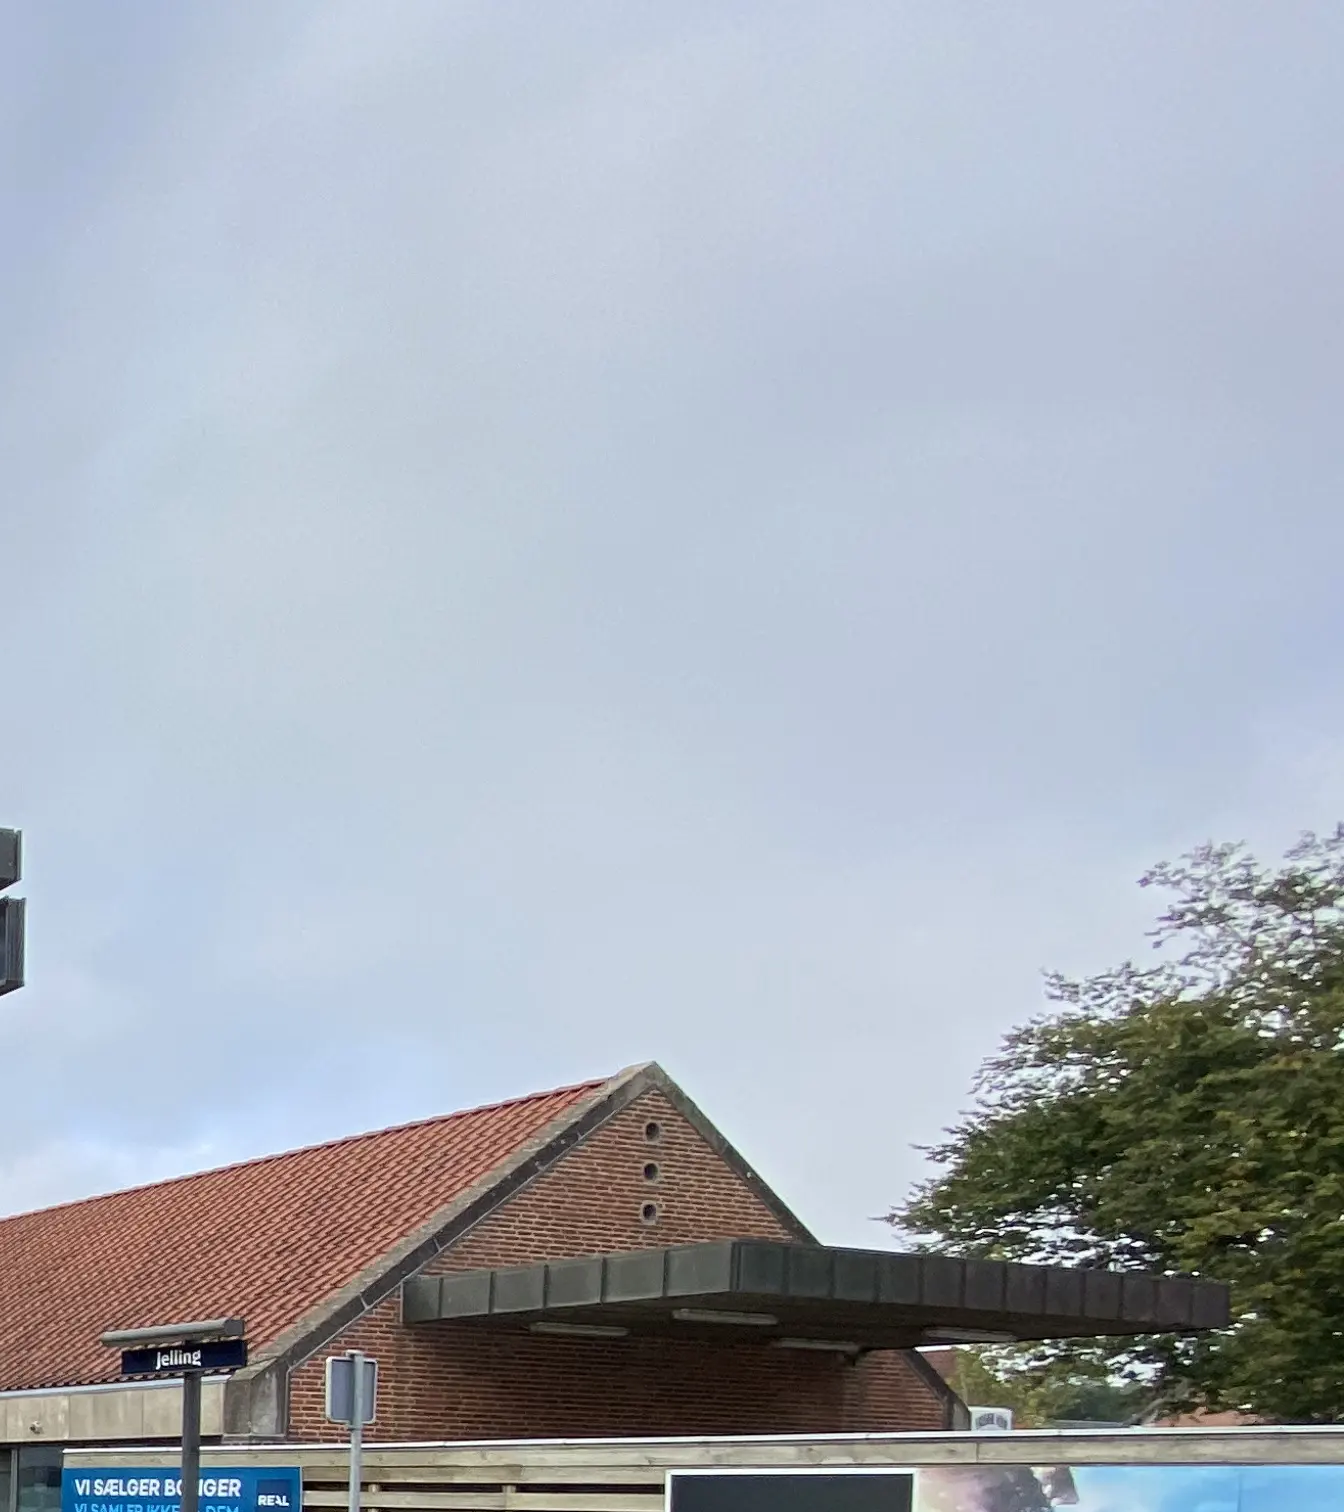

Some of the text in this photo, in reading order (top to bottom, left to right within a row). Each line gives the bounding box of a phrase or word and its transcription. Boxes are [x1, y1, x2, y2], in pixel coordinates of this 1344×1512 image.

[155, 1349, 202, 1370] Jelling
[74, 1479, 90, 1496] VI
[93, 1479, 161, 1497] SÆLGER
[257, 1494, 290, 1507] REAL
